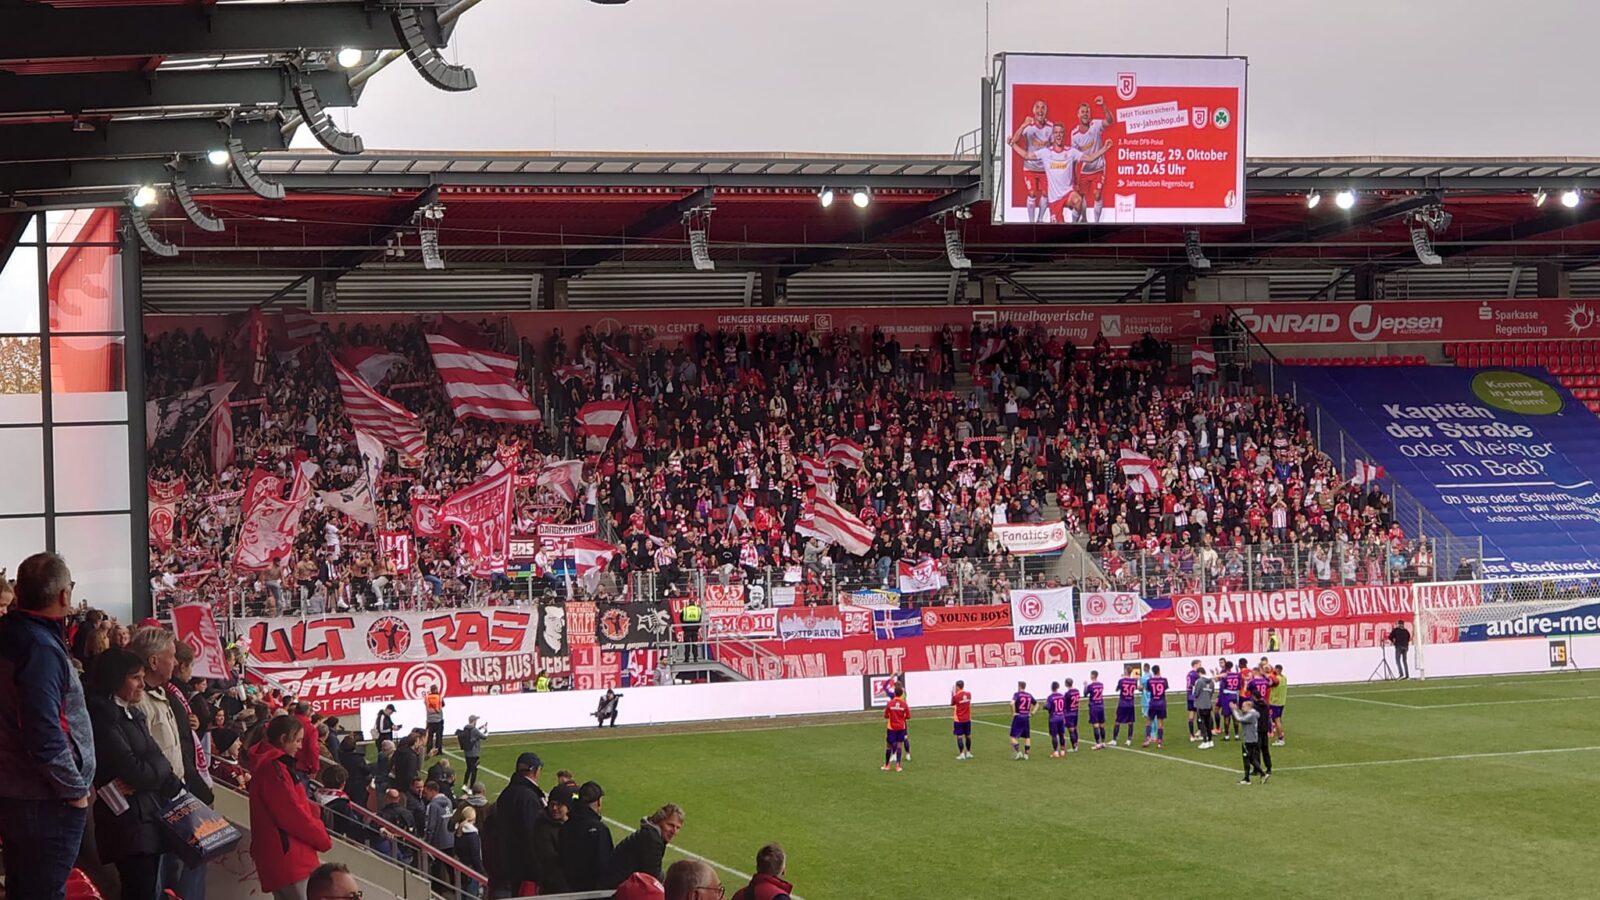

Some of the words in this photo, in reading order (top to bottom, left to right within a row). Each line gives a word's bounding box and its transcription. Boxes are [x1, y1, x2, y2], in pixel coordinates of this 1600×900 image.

[1119, 111, 1134, 119] Jetzt
[1134, 108, 1154, 117] Tickets
[1154, 106, 1176, 114] sichern
[1129, 115, 1185, 130] ssv-jahnshop.de
[1139, 138, 1164, 146] DFB-Pokal
[1118, 148, 1166, 163] Dienstag,
[1168, 149, 1184, 161] 29.
[1186, 149, 1228, 161] Oktober
[1117, 165, 1134, 175] um
[1136, 163, 1166, 175] 20.45
[1167, 163, 1187, 175] Uhr
[1126, 180, 1160, 188] Jahnstadion
[1161, 180, 1194, 189] Regensburg
[718, 315, 754, 324] GIENGER
[756, 315, 810, 324] REGENSTAUF
[999, 310, 1094, 324] Mittelbayerische
[1495, 310, 1539, 321] Sparkasse
[896, 325, 933, 333] BACKEN
[1124, 323, 1173, 334] Attenkofer
[1495, 324, 1547, 335] Regensburg
[1485, 380, 1532, 389] Komm
[1504, 398, 1548, 406] Team!
[1383, 403, 1496, 422] Kapitän
[1386, 422, 1433, 438] der
[1437, 422, 1533, 438] Straße
[1400, 441, 1456, 458] oder
[1459, 439, 1558, 457] Meister
[1442, 460, 1482, 477] im
[1481, 460, 1548, 476] Bad?
[1441, 494, 1461, 505] Ob
[1463, 494, 1490, 504] Bus
[1490, 493, 1518, 503] oder
[1468, 504, 1488, 513] wir
[1491, 503, 1531, 513] bieten
[1535, 503, 1556, 513] dir
[1487, 514, 1517, 523] Jobs
[1519, 514, 1541, 522] mit
[1002, 529, 1049, 541] Fanatics
[1201, 590, 1316, 624] RATINGEN
[939, 611, 978, 623] YOUNG
[981, 609, 1009, 621] BOYS
[1018, 622, 1069, 636] KERZENHEIM
[925, 642, 1025, 672] WEISS
[460, 657, 502, 682] ALLES
[505, 654, 531, 680] AUS
[534, 652, 571, 675] LIEBE
[262, 667, 400, 698] Fortuna
[1226, 678, 1239, 690] 39
[1122, 684, 1136, 696] 30
[1151, 683, 1164, 696] 19
[1256, 684, 1267, 697] 18
[1019, 697, 1032, 710] 21
[1053, 699, 1064, 712] 10
